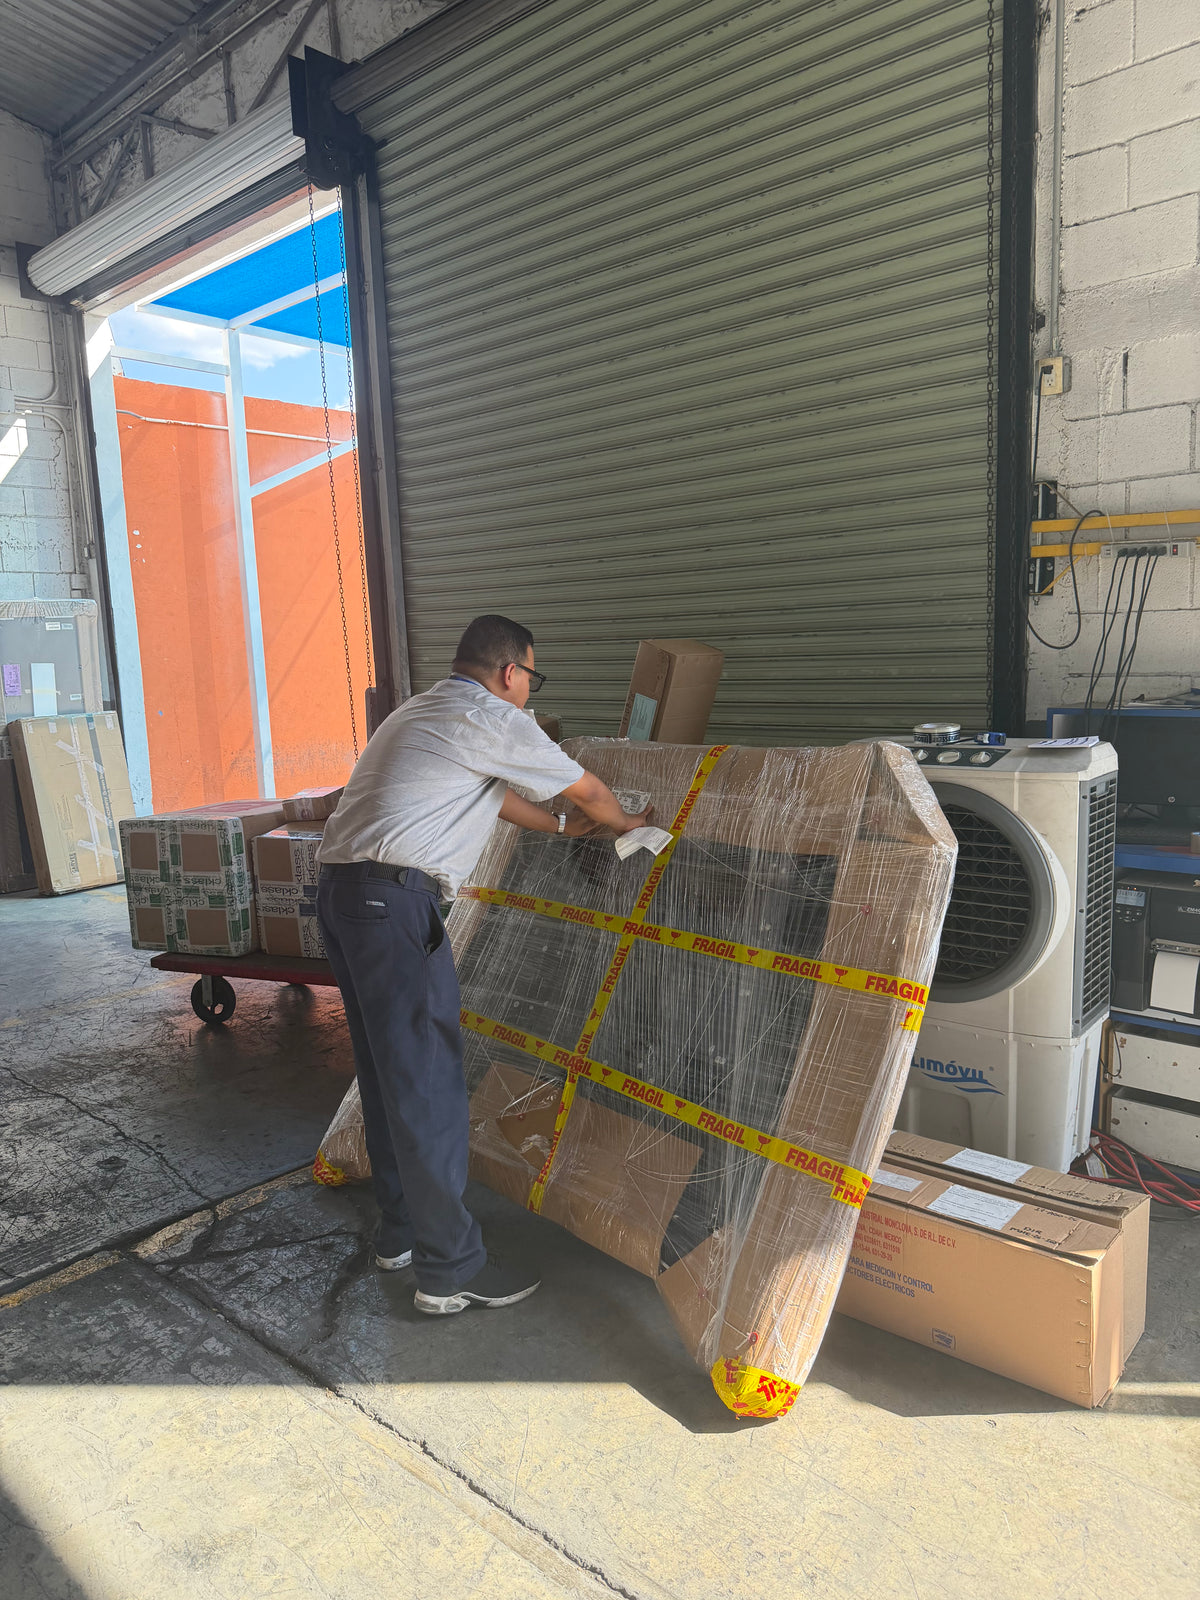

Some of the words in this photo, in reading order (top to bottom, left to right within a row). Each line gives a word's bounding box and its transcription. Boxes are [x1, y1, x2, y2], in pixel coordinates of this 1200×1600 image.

[672, 787, 701, 831] FRAGIL
[182, 876, 222, 886] cklass
[294, 847, 303, 885] klass
[261, 885, 299, 896] cklass
[637, 863, 666, 910] FRAGIL
[303, 924, 311, 958] klass
[504, 894, 537, 911] FRAGIL
[560, 906, 596, 925] FRAGIL
[622, 920, 661, 942] FRAGIL
[691, 937, 736, 959] FRAGIL
[771, 955, 822, 980] FRAGIL
[864, 974, 926, 1006] FRAGIL
[601, 945, 630, 994] FRAGIL
[491, 1024, 527, 1049] FRAGIL
[553, 1049, 592, 1077] FRAGIL
[621, 1078, 664, 1109] FRAGIL
[697, 1111, 745, 1145] FRAGIL
[785, 1147, 847, 1187] FRAGIL
[919, 1228, 928, 1239] DE
[938, 1234, 947, 1246] DE
[865, 1260, 897, 1279] MEDICION
[896, 1273, 902, 1281] Y
[902, 1274, 935, 1294] CONTROL
[874, 1277, 916, 1298] ELECTRICOS
